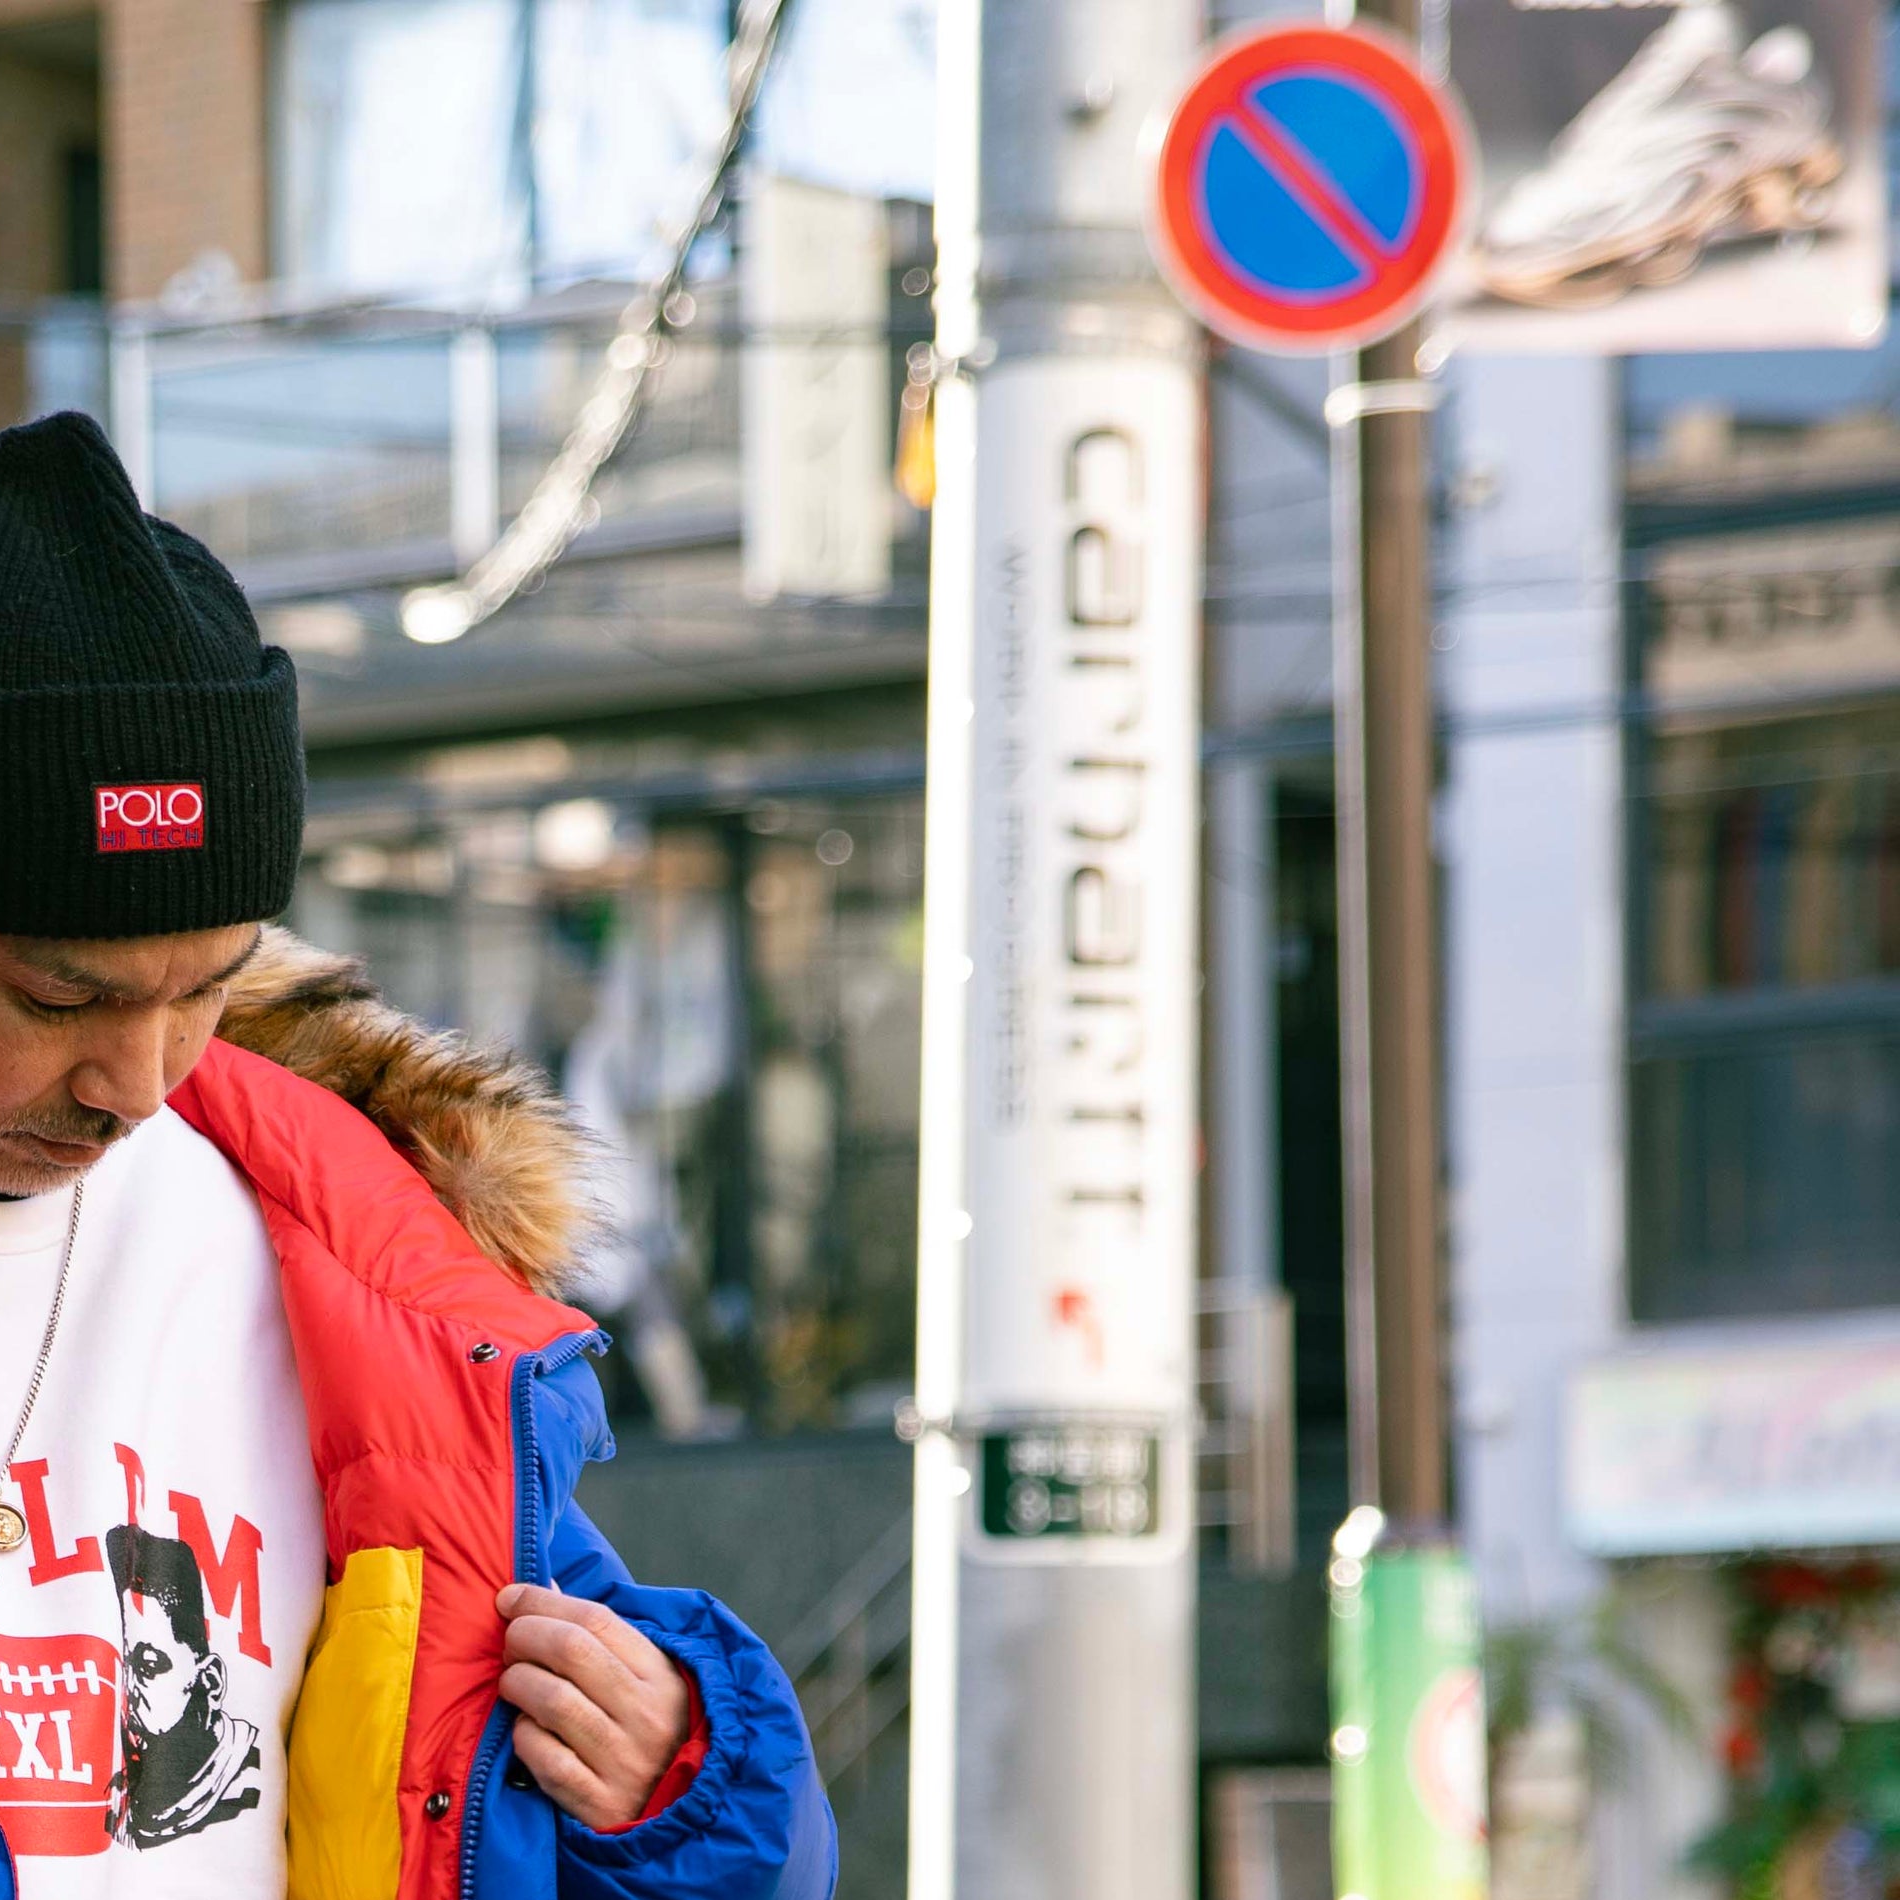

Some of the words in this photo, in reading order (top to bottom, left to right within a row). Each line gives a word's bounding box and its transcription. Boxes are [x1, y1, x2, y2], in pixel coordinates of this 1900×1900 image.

[99, 788, 203, 828] POLO
[101, 829, 126, 849] HI
[138, 826, 199, 847] TECH
[1063, 422, 1146, 1238] carhartt
